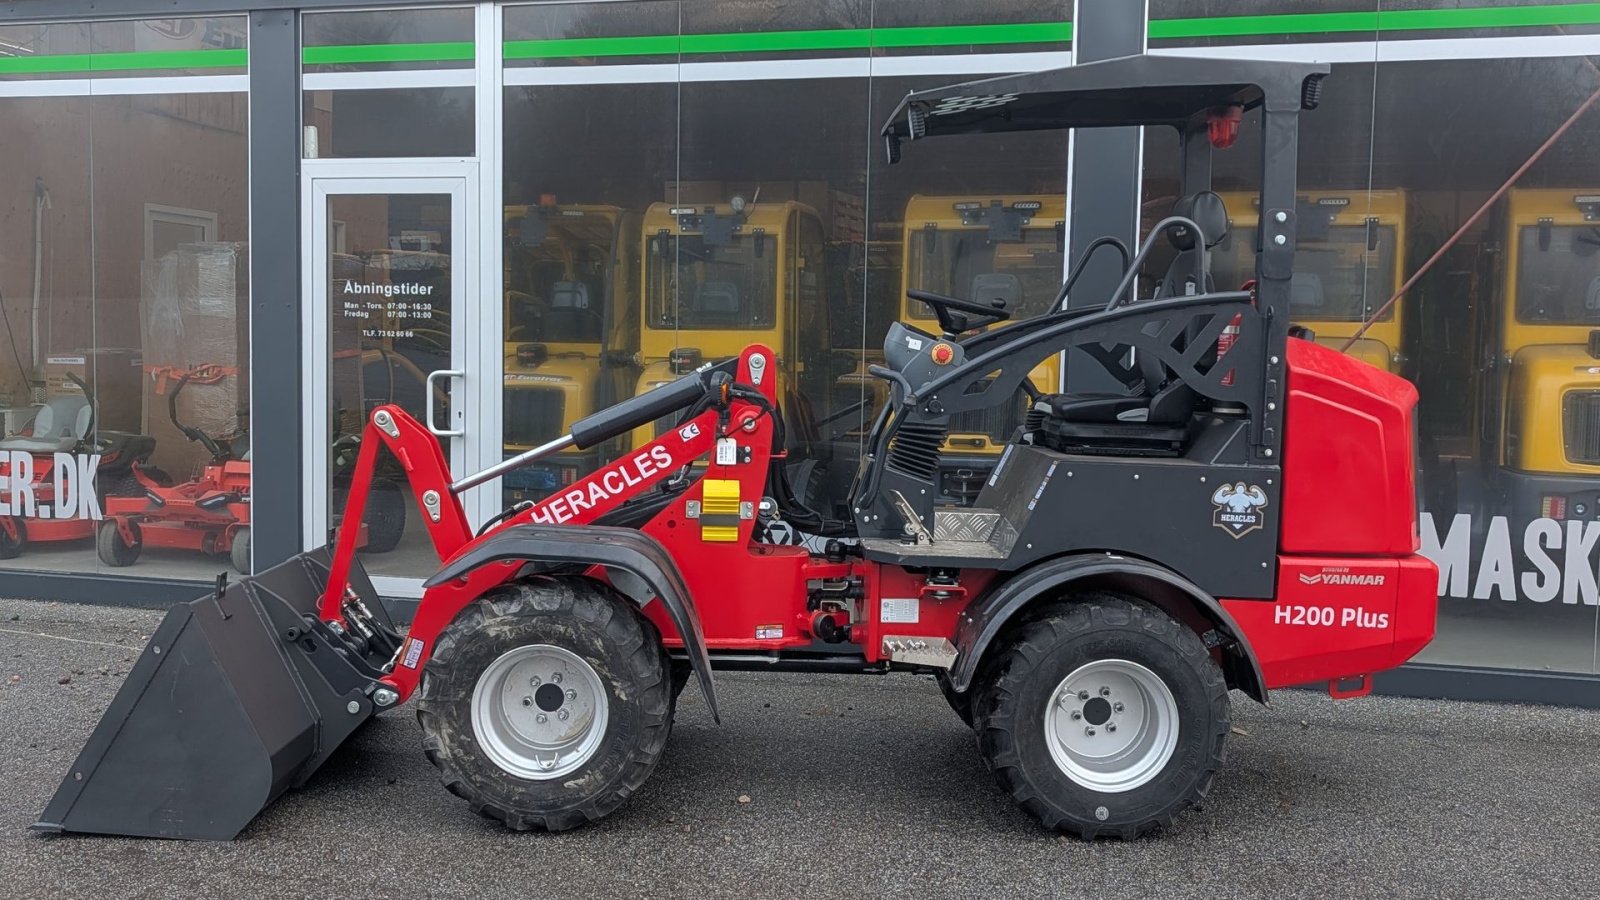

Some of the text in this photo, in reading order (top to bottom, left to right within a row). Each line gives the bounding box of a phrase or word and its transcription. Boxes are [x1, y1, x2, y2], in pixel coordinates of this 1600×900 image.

[344, 280, 433, 297] Åbningstider
[344, 310, 369, 319] Fredag
[412, 311, 432, 319] 13:00
[531, 445, 673, 525] HERACLES
[1220, 514, 1257, 523] HERACLES
[1321, 574, 1385, 586] YANMAR
[1275, 605, 1389, 628] H200 Plus
